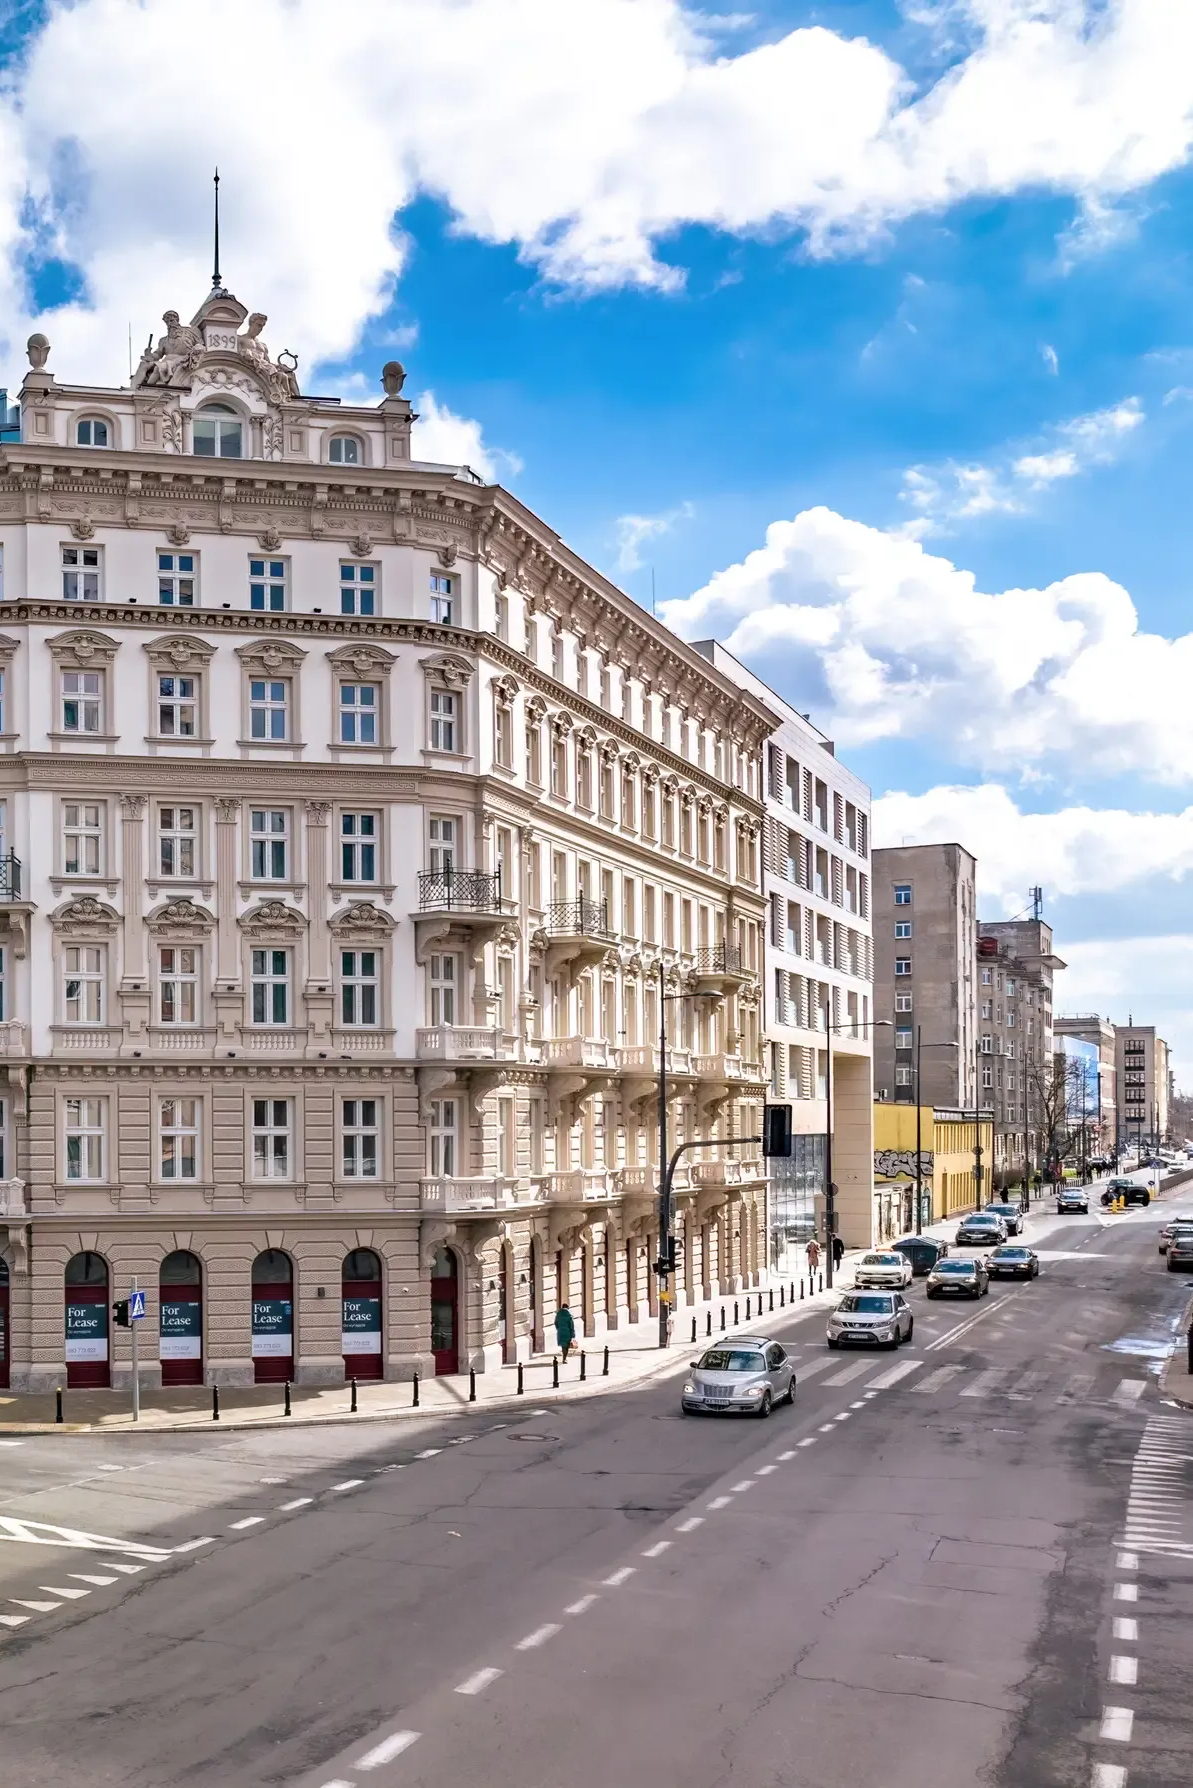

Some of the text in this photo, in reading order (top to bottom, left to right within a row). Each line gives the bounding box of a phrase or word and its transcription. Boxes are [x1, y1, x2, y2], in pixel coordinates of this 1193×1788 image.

[208, 334, 236, 349] 1899
[161, 1305, 180, 1316] For
[253, 1303, 272, 1314] For
[343, 1301, 361, 1311] For
[68, 1307, 86, 1317] For
[343, 1312, 372, 1322] Lease
[67, 1318, 98, 1328] Lease
[161, 1316, 192, 1326] Lease
[253, 1314, 283, 1324] Lease
